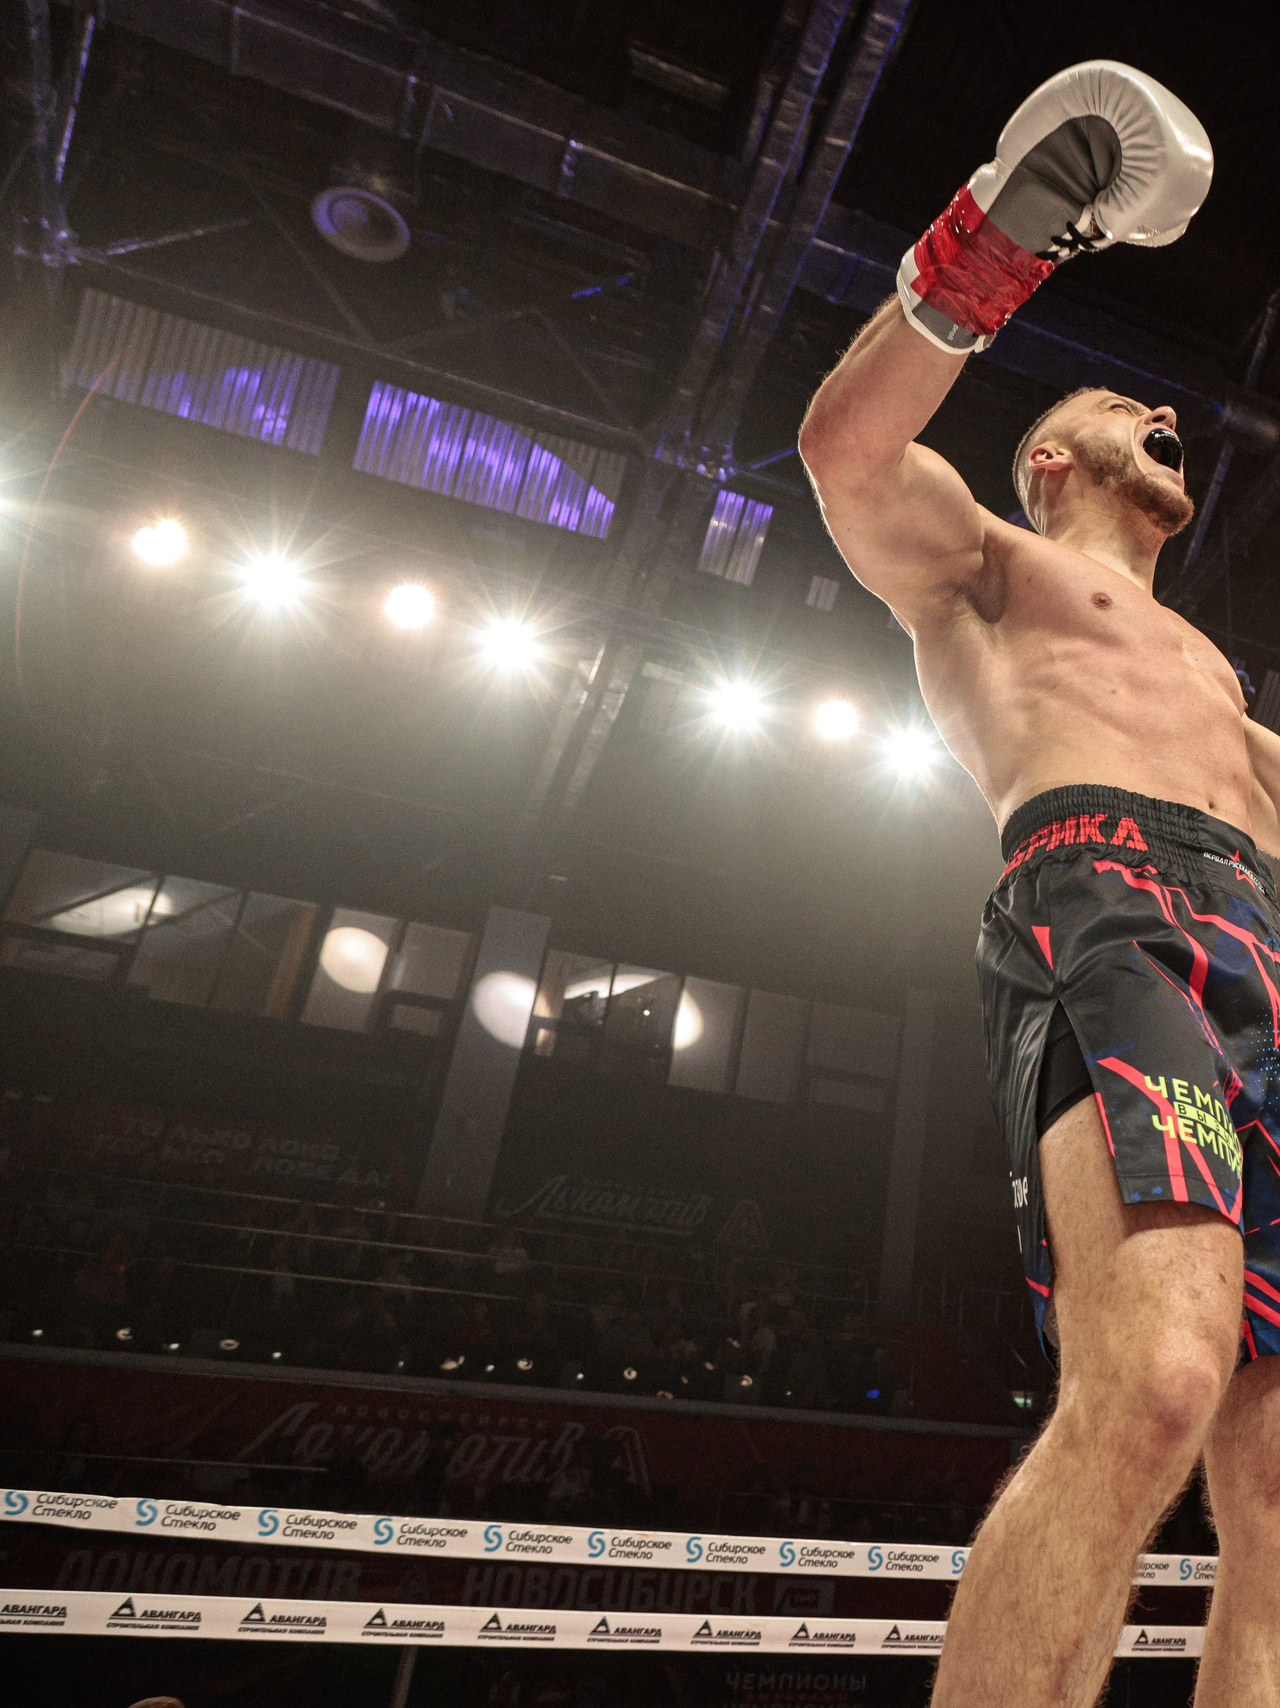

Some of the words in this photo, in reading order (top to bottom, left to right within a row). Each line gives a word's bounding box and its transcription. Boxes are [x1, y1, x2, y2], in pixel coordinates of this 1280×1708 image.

[35, 1493, 118, 1509] Сибирское
[32, 1505, 92, 1520] Стекло
[165, 1504, 241, 1521] Сибирское
[161, 1516, 217, 1531] Стекло
[285, 1514, 358, 1530] Сибирское
[282, 1526, 335, 1540] Стекло
[399, 1524, 468, 1538] Сибирское
[508, 1530, 573, 1544] Сибирское
[396, 1535, 447, 1548] Стекло
[611, 1536, 672, 1550] Сибирское
[505, 1542, 553, 1554] Стекло
[608, 1548, 653, 1560] Стекло
[708, 1542, 766, 1554] Сибирское
[800, 1547, 855, 1559] Сибирское
[705, 1552, 748, 1564] Стекло
[798, 1557, 838, 1568] Стекло
[887, 1551, 940, 1563] Сибирское
[885, 1561, 924, 1572] Стекло
[461, 1565, 758, 1614] НОВОСИБИРСК
[1, 1604, 67, 1618] АВАНГАРД
[140, 1609, 202, 1622] АВАНГАРД
[270, 1615, 327, 1627] АВАНГАРД
[391, 1620, 445, 1631] АВАНГАРД
[506, 1624, 557, 1634] АВАНГАРД
[614, 1627, 662, 1637] АВАНГАРД
[716, 1630, 761, 1640] АВАНГАРД
[813, 1633, 856, 1642] АВАНГАРД
[1151, 1638, 1186, 1646] АВАНГАРД
[725, 1672, 867, 1692] ЧЕМПИОНЫ
